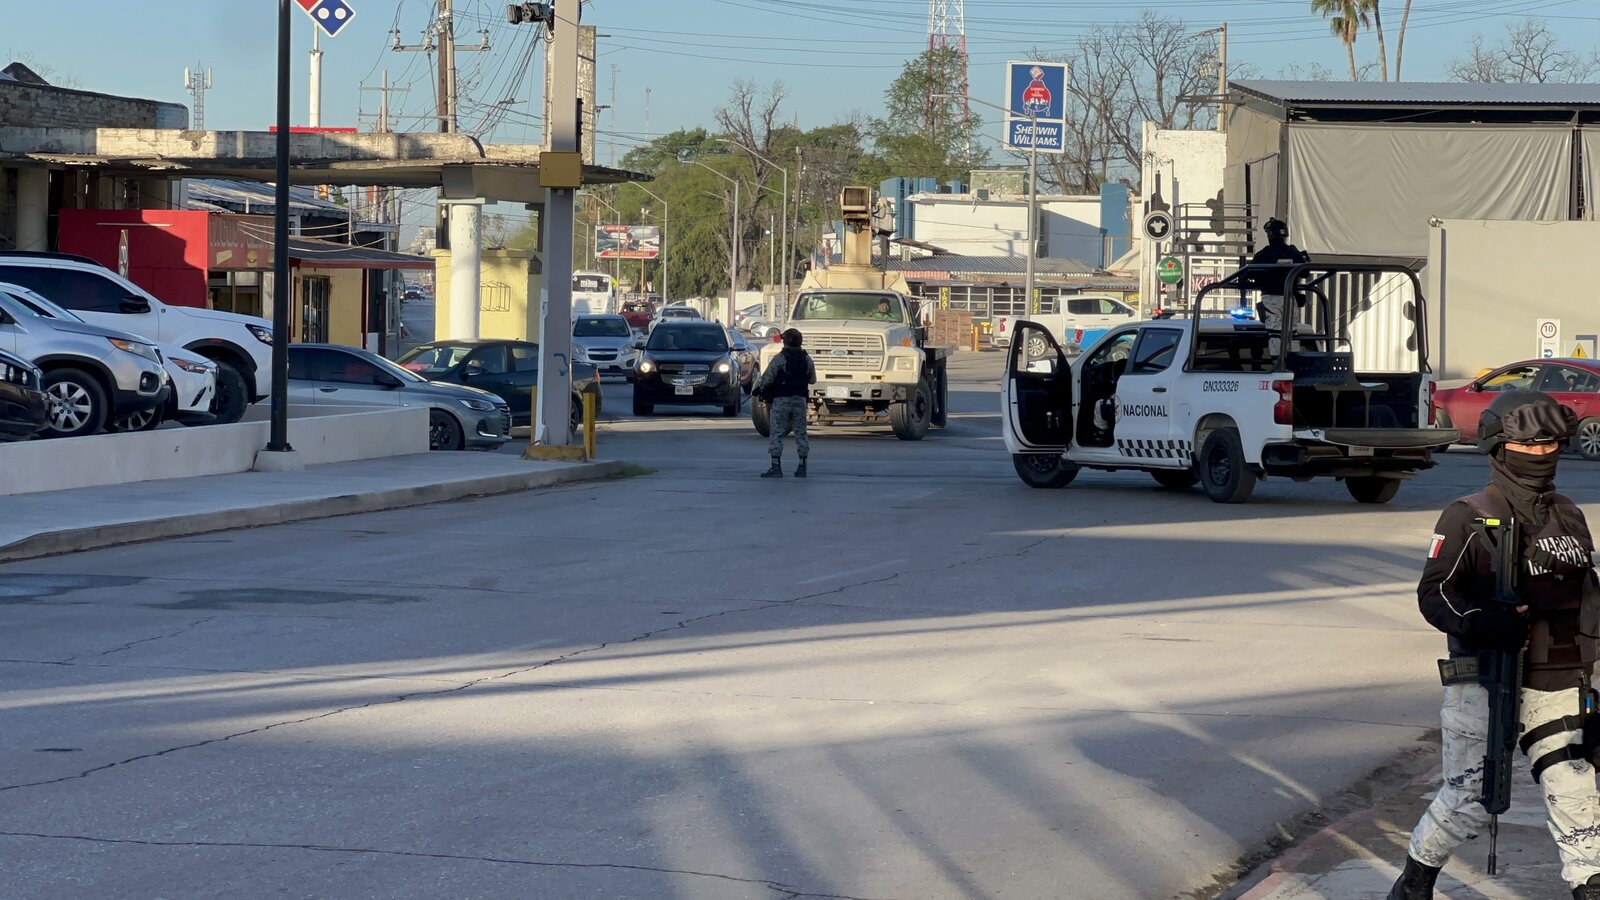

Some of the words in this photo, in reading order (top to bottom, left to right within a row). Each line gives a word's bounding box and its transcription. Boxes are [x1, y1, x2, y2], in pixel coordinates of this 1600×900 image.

[1544, 325, 1554, 333] 10
[1202, 380, 1239, 392] GN333326
[1122, 404, 1168, 418] NACIONAL
[1536, 535, 1580, 554] UARDIA
